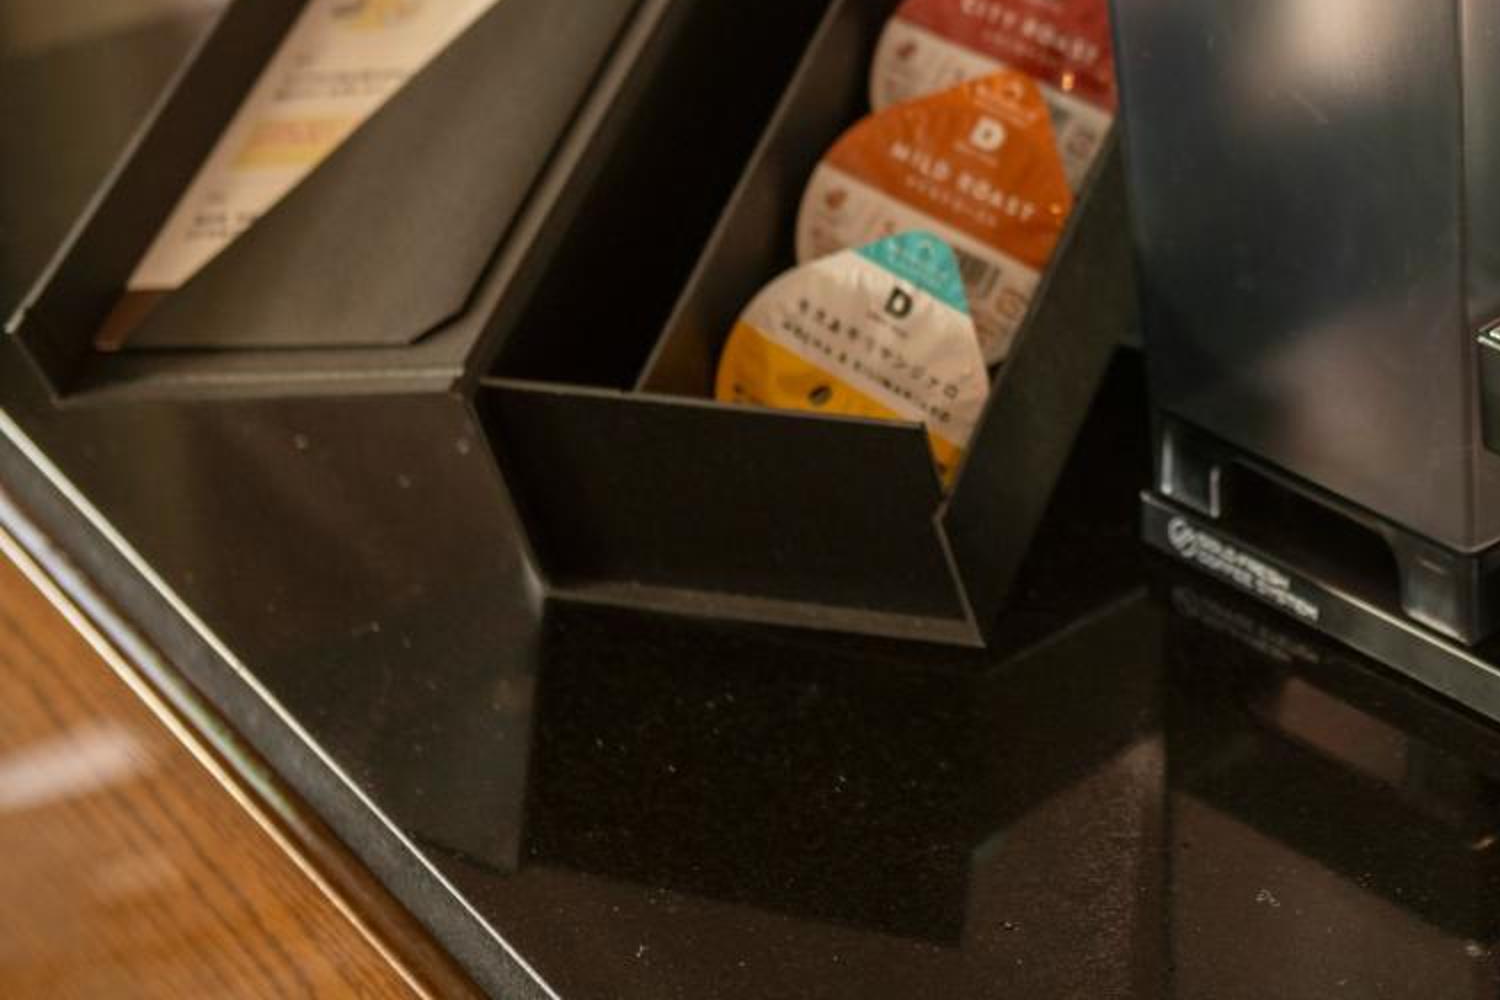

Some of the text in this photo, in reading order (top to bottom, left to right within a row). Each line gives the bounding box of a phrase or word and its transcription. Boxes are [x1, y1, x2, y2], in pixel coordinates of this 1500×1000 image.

[889, 140, 951, 182] MILD
[958, 170, 1037, 224] ROAST
[884, 286, 914, 320] D
